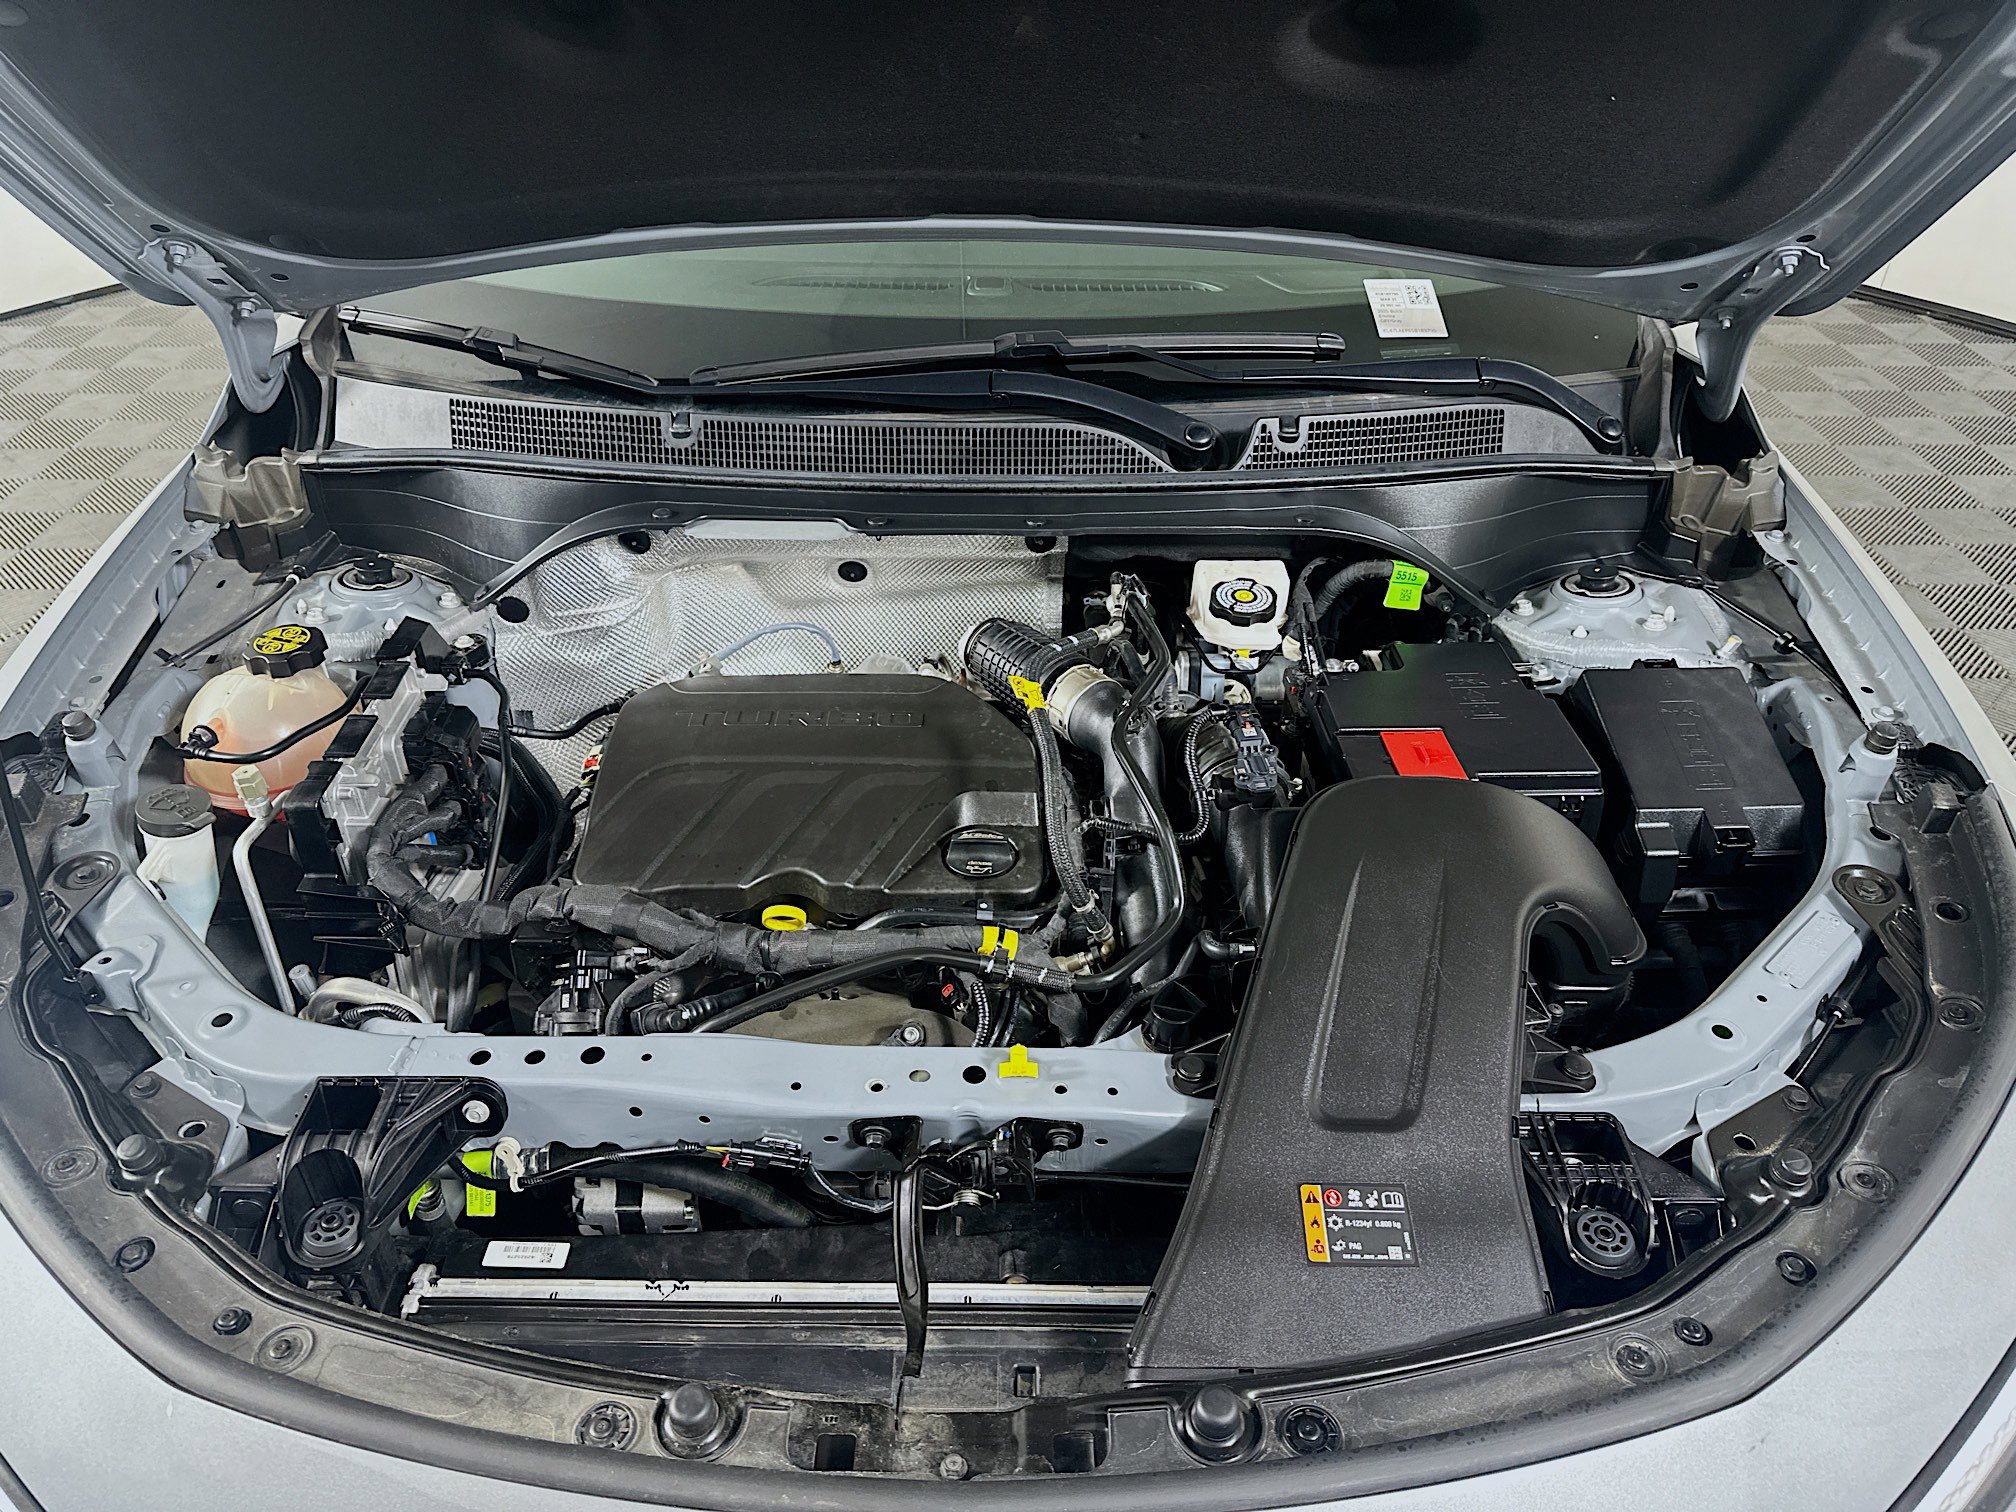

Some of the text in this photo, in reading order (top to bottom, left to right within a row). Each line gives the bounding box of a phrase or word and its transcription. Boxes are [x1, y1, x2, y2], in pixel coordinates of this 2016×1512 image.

[1395, 570, 1417, 581] 5515
[674, 709, 926, 728] TURBO
[1348, 1200, 1363, 1208] AUTO
[1392, 1220, 1402, 1230] kg
[1348, 1242, 1363, 1251] PAG
